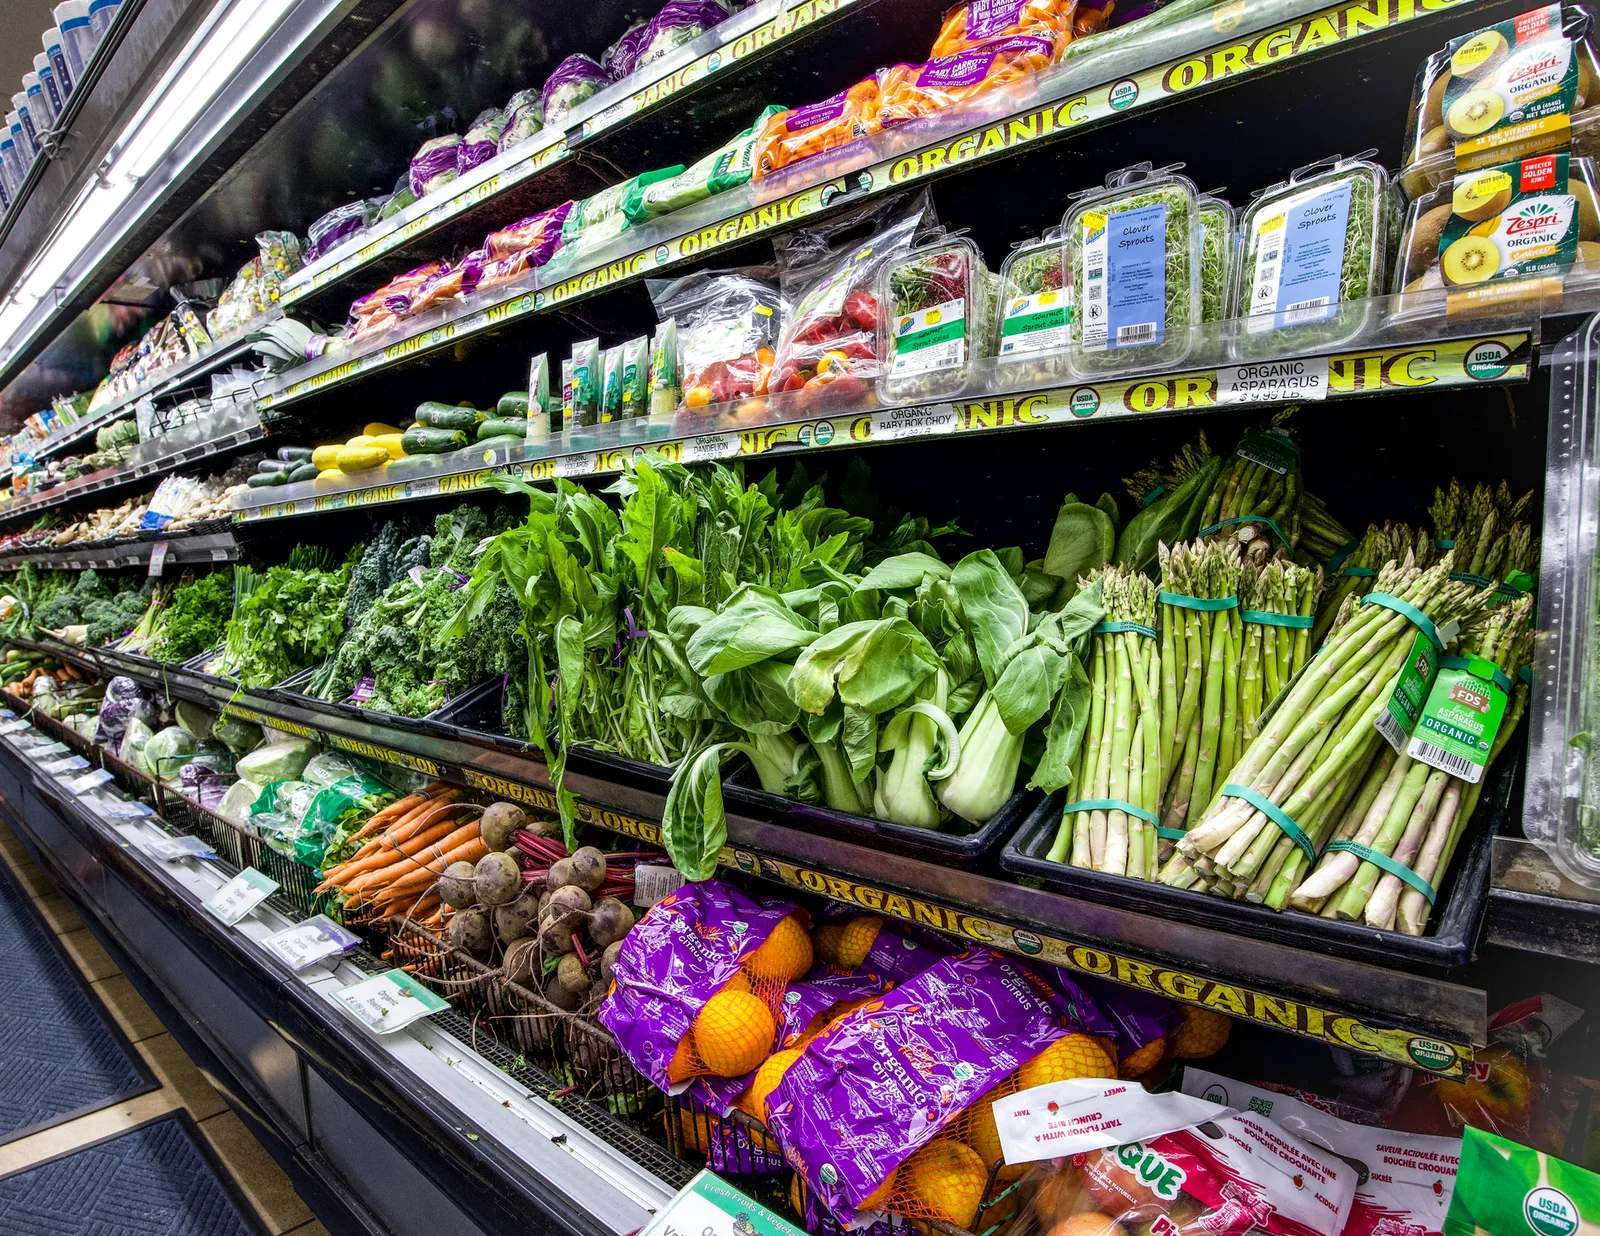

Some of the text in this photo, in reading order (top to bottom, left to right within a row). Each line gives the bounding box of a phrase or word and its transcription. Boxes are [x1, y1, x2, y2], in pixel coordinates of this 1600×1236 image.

[1517, 20, 1546, 33] GOLDEN
[952, 58, 989, 72] CARROTS
[1508, 55, 1557, 83] Zespri
[1114, 86, 1135, 98] USDA
[1510, 74, 1559, 94] ORGANIC
[1526, 103, 1566, 119] NET WEIGHT
[889, 97, 1088, 185] ORGANIC
[1476, 137, 1486, 145] 3X
[1488, 132, 1503, 142] THE
[1504, 123, 1537, 138] VITAMIN
[1523, 168, 1553, 179] GOLDEN
[1524, 161, 1552, 171] SWEETER
[1530, 176, 1545, 184] KIWI
[1303, 202, 1335, 217] Clover
[680, 195, 810, 256] ORGANIC
[1123, 224, 1151, 236] Clover
[1298, 213, 1337, 230] Sprouts
[1506, 213, 1557, 236] Zespri
[1118, 235, 1155, 249] Sprouts
[1507, 233, 1558, 248] ORGANIC
[1526, 264, 1537, 272] 1LB
[553, 254, 646, 302] ORGANIC
[1467, 291, 1477, 299] 3X
[1479, 288, 1493, 297] THE
[1496, 284, 1529, 294] VITAMIN
[1032, 309, 1062, 321] Gourmet
[1021, 320, 1047, 332] Sprout
[912, 333, 950, 350] Sprout Salad
[1475, 350, 1502, 362] USDA
[1237, 362, 1305, 380] ORGANIC
[1231, 375, 1319, 393] ASPARAGUS
[1076, 394, 1094, 402] USDA
[891, 408, 932, 419] ORGANIC
[1074, 403, 1096, 411] ORGANIC
[880, 415, 952, 430] BABY BOK CHOY
[693, 442, 729, 453] DANDELION
[1395, 688, 1416, 717] ORGANIC
[1457, 690, 1481, 706] FDS
[1438, 707, 1485, 732] ASPARAGUS
[1426, 718, 1475, 745] ORGANIC
[340, 738, 397, 763] ORGANIC
[796, 868, 994, 941] ORGANIC
[678, 935, 704, 963] CITRUS
[378, 990, 399, 1006] Organic
[1000, 978, 1032, 1011] CITRUS
[1066, 944, 1381, 1052] ORGANIC
[1419, 1039, 1447, 1052] USDA
[1415, 1049, 1450, 1063] ORGANIC
[873, 1037, 927, 1106] organic
[872, 1062, 903, 1100] CITRUS
[1104, 1086, 1126, 1098] SWEET
[1014, 1109, 1030, 1118] TART
[1048, 1112, 1102, 1129] CRUNCH BITE
[1035, 1118, 1122, 1142] TART FLAVOR WITH A
[1228, 1133, 1253, 1154] SUCRÉE
[1233, 1115, 1337, 1181] SAVEUR ACIDULÉE AVEC UNE
[1243, 1126, 1326, 1185] BOUCHÉE CROQUANTE
[1376, 1144, 1460, 1165] SAVEUR ACIDULÉE AVEC
[1383, 1156, 1417, 1168] BOUCHÉE
[1107, 1141, 1183, 1196] QUE
[1371, 1172, 1393, 1183] SUCRÉE
[704, 1183, 731, 1201] Fresh
[731, 1193, 758, 1213] Fruits
[758, 1208, 765, 1217] &
[1112, 1181, 1138, 1205] NATURELLE
[1314, 1192, 1340, 1215] ACIDULÉ
[1538, 1196, 1568, 1217] USDA
[1532, 1210, 1571, 1231] ORGANIC
